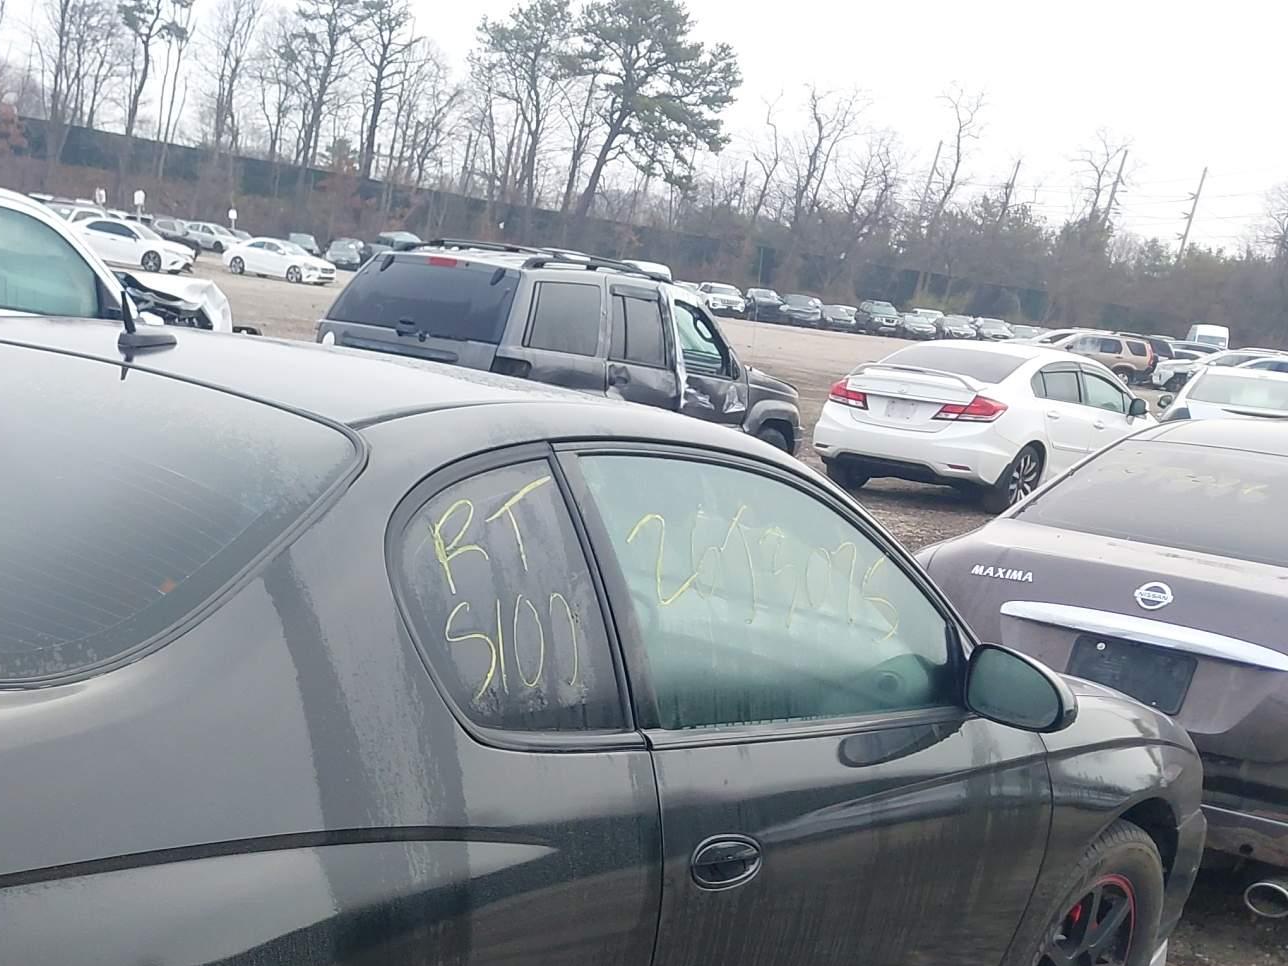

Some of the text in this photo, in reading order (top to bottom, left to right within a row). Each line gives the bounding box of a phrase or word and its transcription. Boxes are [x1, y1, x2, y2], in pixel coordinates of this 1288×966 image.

[428, 475, 552, 595] RT
[971, 564, 1034, 582] MAXIMA
[1137, 590, 1170, 602] NISSAN
[444, 592, 579, 704] S100
